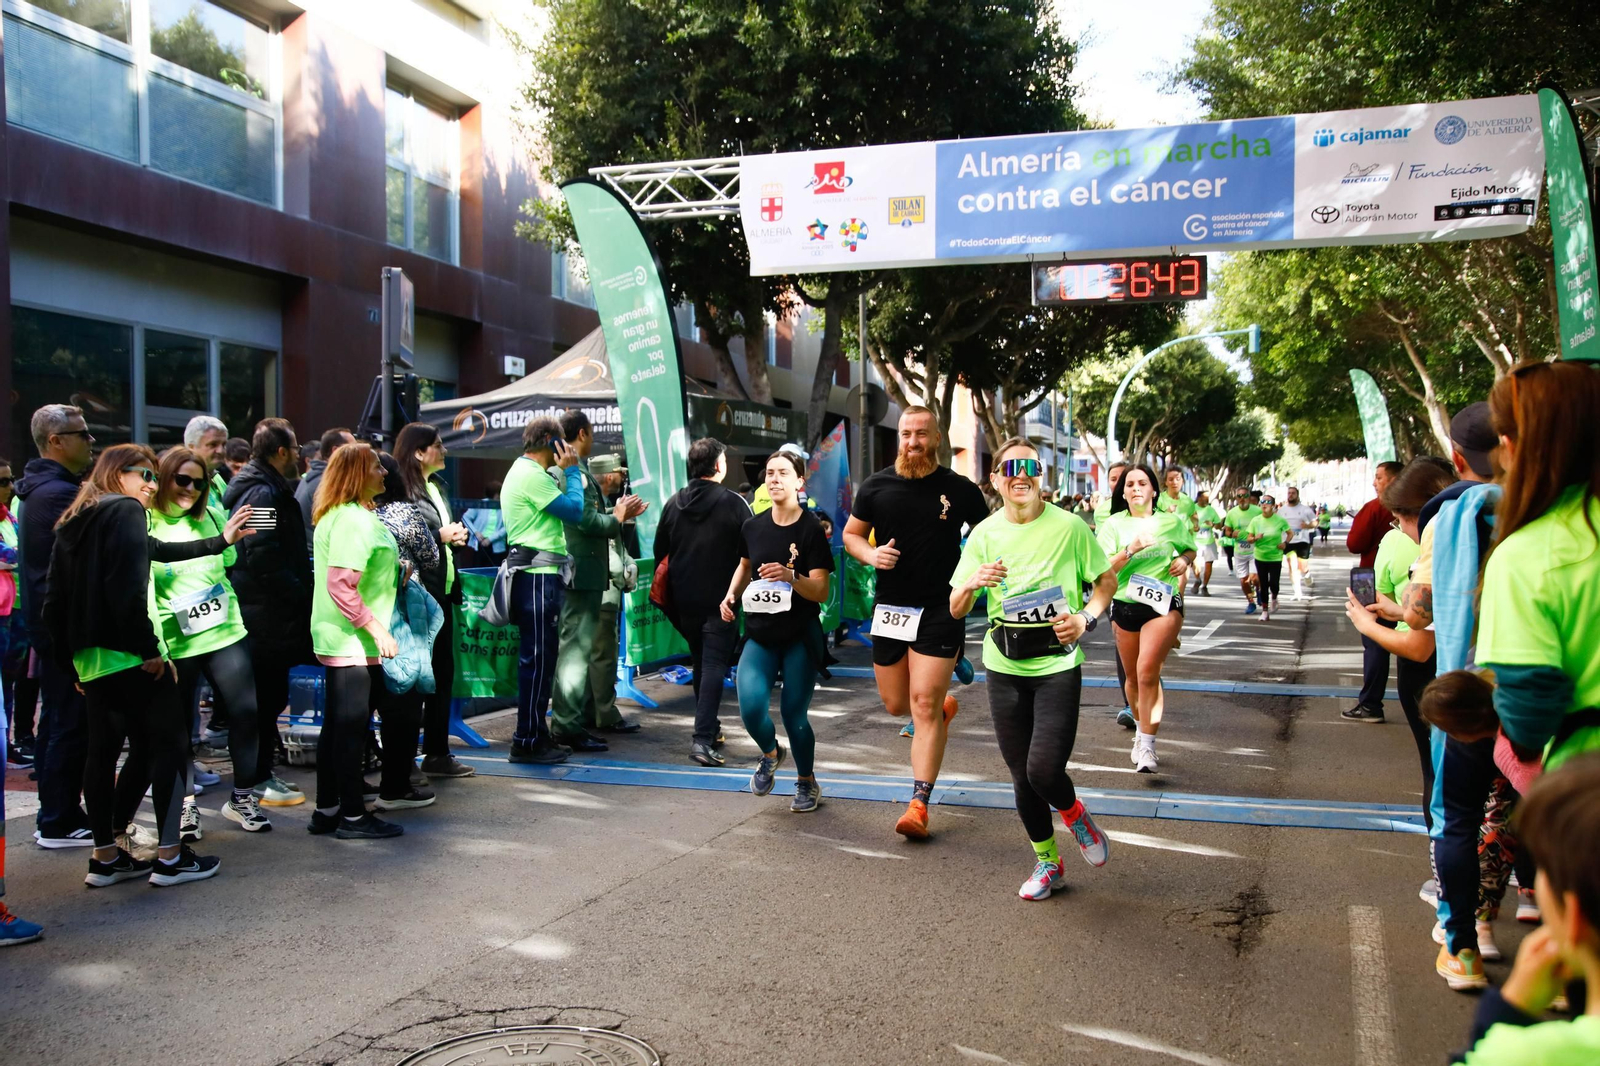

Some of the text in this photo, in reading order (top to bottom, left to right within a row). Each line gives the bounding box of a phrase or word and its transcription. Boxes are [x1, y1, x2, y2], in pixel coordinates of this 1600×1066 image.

[1467, 116, 1533, 129] UNIVERSIDAD
[1340, 127, 1412, 145] cajamar
[1467, 124, 1532, 137] DE ALMERÍA
[957, 133, 1272, 179] Almería en marcha
[1340, 163, 1493, 185] MICHELIN Fundación
[957, 176, 1228, 214] contra el cáncer
[1451, 185, 1521, 201] Ejido Motor
[1345, 203, 1380, 213] Toyota
[1211, 210, 1285, 222] asociación española
[1345, 212, 1419, 224] Alborán Motor
[1212, 221, 1236, 230] contra
[1244, 219, 1270, 229] cáncer
[1223, 227, 1254, 237] Almería
[750, 226, 793, 240] ALMERÍA
[949, 234, 1052, 249] #TodosContraElCáncer
[751, 590, 782, 604] 335
[1137, 585, 1163, 603] 163
[188, 597, 222, 620] 493
[1017, 603, 1058, 622] 514
[881, 611, 911, 628] 387
